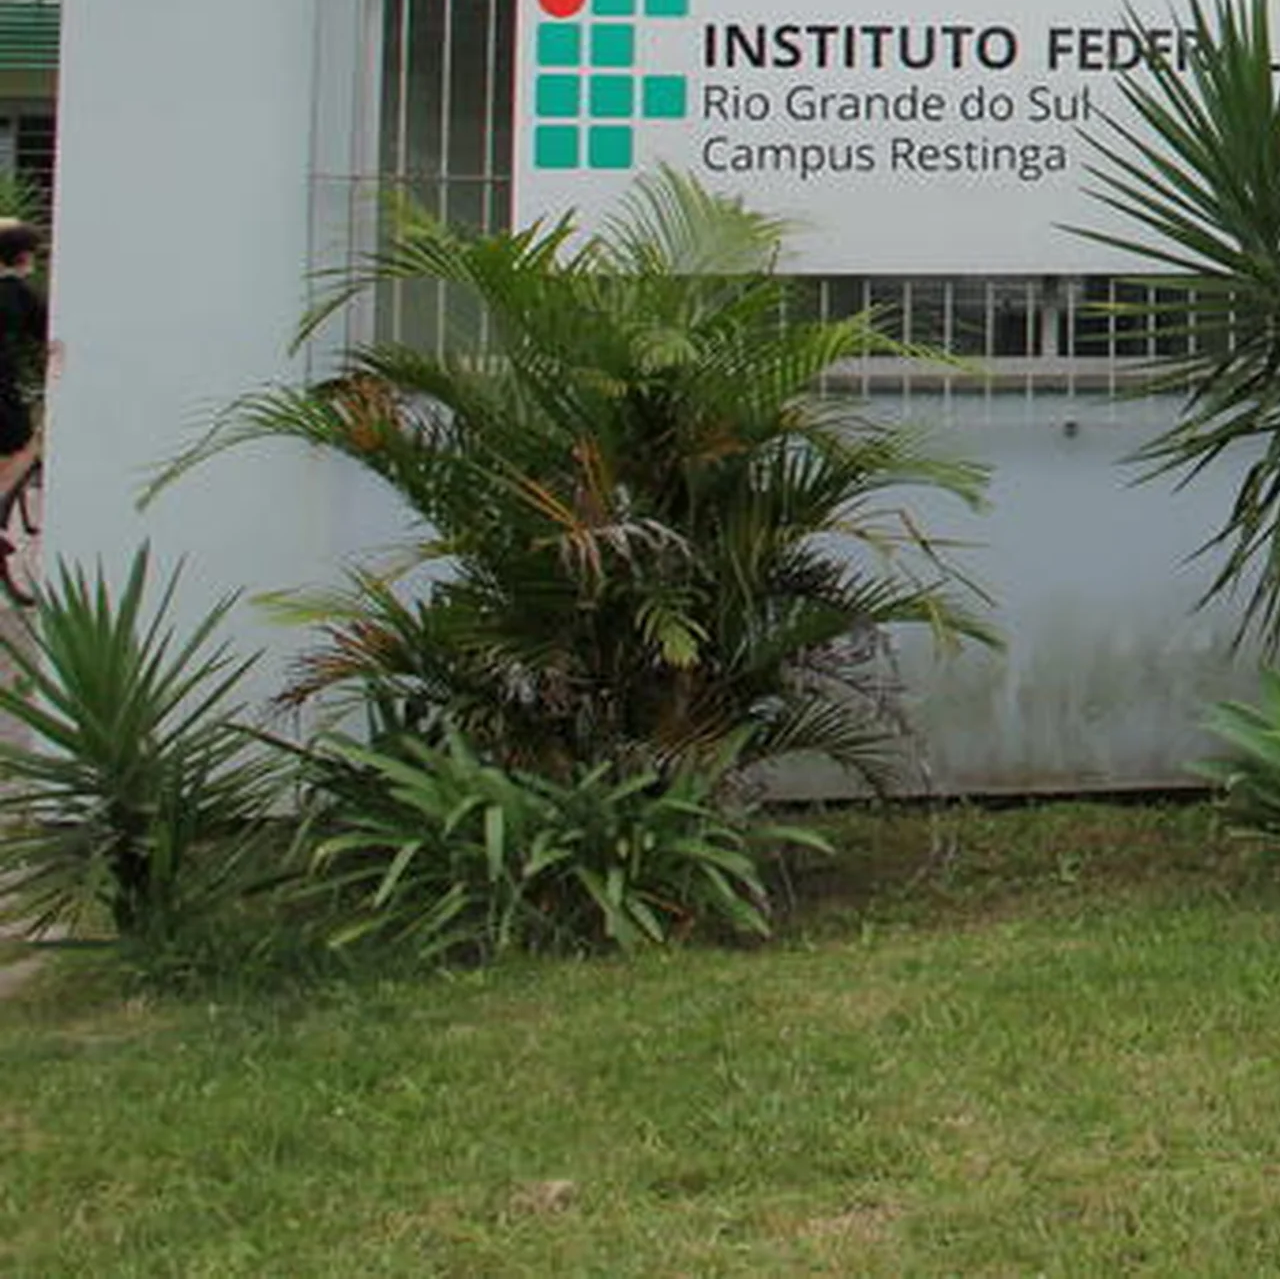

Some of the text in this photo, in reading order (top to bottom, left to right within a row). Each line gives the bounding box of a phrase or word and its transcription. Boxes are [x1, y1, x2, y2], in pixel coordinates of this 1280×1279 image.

[704, 23, 1017, 70] INSTITUTO
[703, 84, 1090, 121] Rio Grande do Sul
[703, 136, 1066, 182] Campus Restinga
